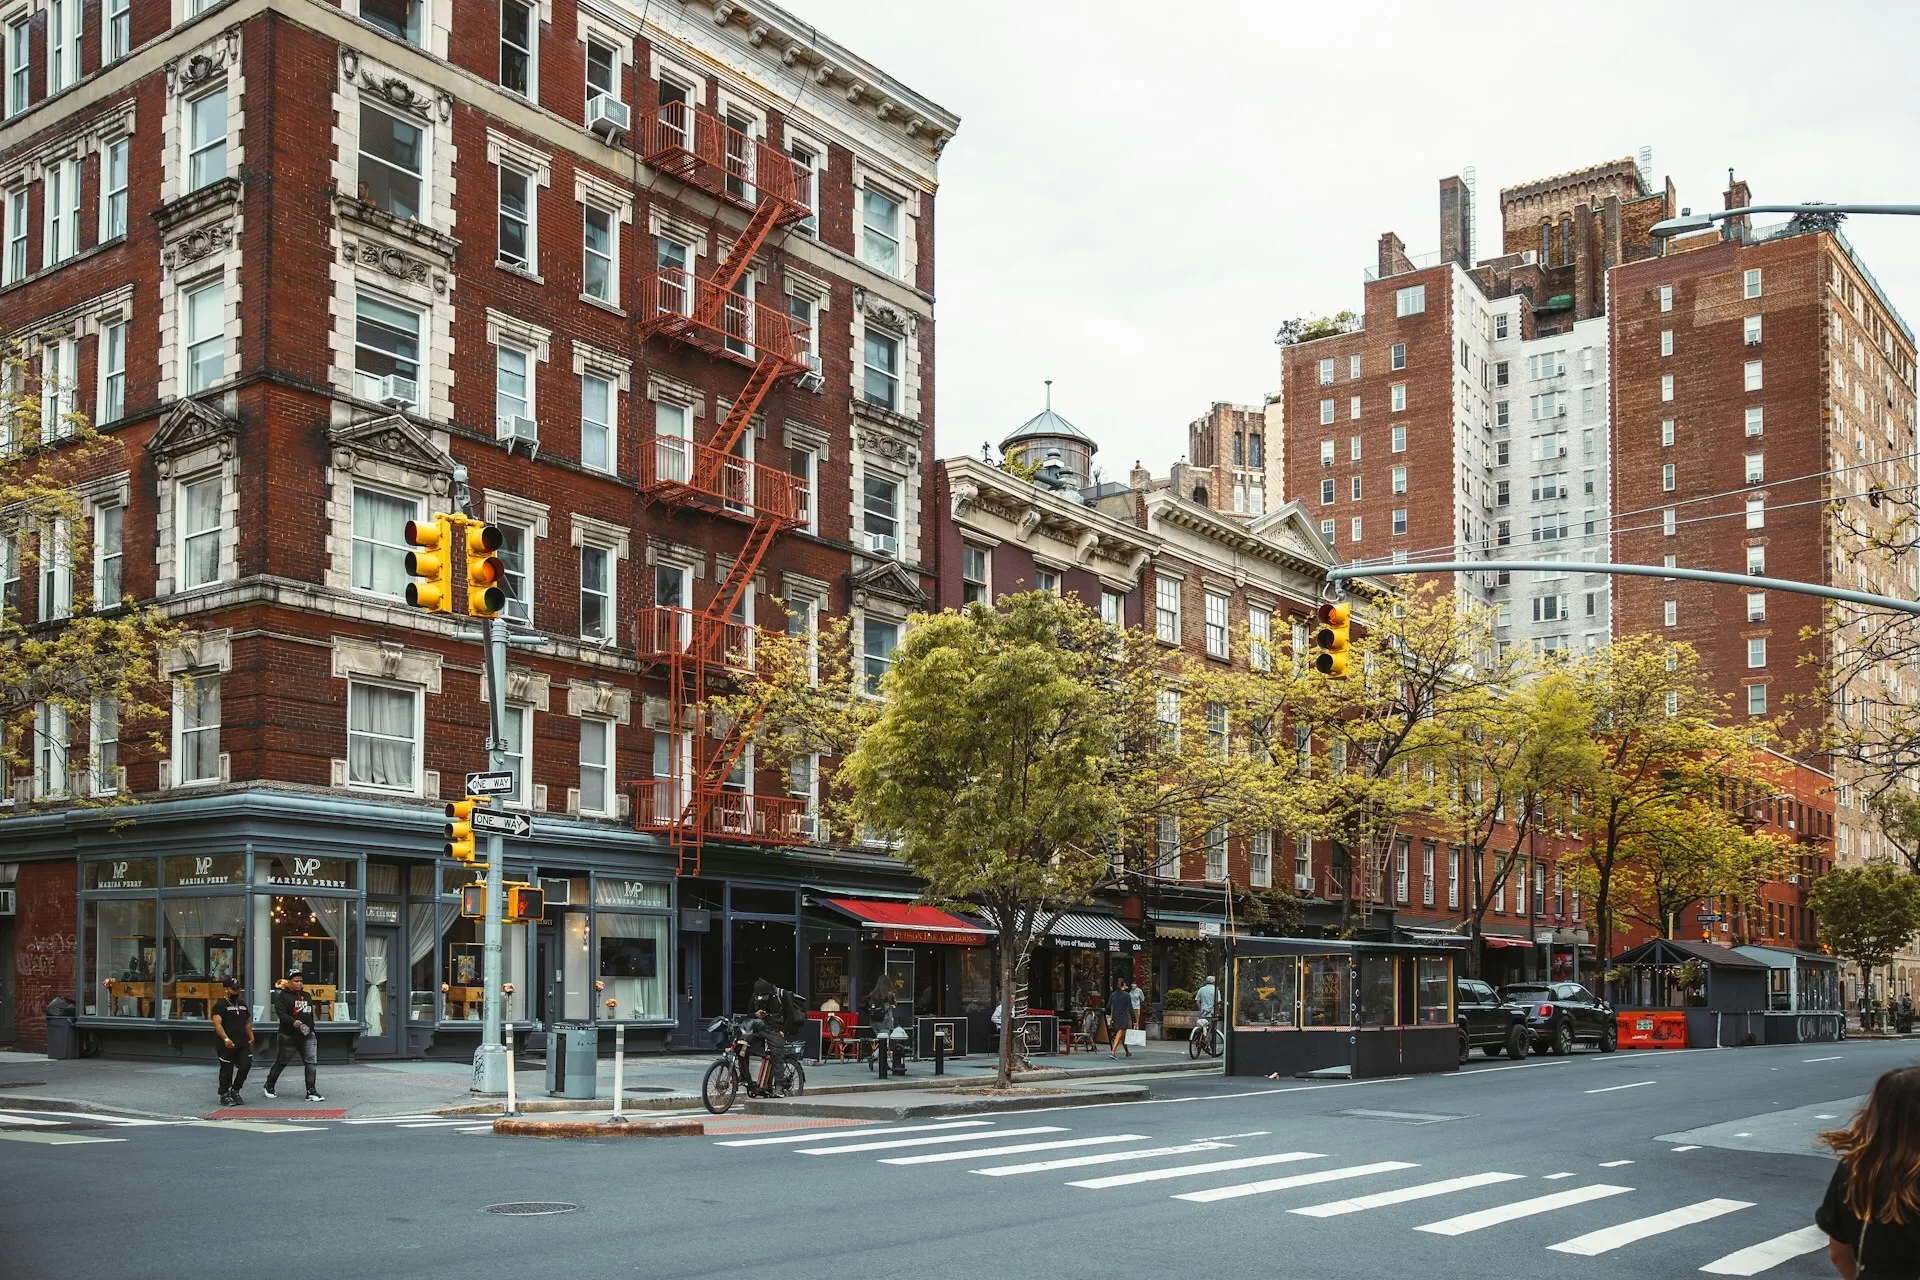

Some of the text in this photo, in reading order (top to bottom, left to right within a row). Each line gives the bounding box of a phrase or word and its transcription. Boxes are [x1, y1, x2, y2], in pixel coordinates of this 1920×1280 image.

[472, 778, 508, 789] ONE WAY
[476, 815, 522, 829] ONE WAY
[113, 861, 128, 879] MP
[195, 856, 212, 875] MP
[294, 857, 320, 876] MP
[179, 876, 228, 885] MARISA PERRY
[266, 876, 346, 888] MARISA PERRY
[624, 881, 643, 897] MP
[605, 897, 635, 905] MARISA
[893, 930, 922, 940] HUDSON
[924, 933, 938, 941] BAR
[1055, 938, 1070, 947] Myers
[310, 989, 324, 997] MP
